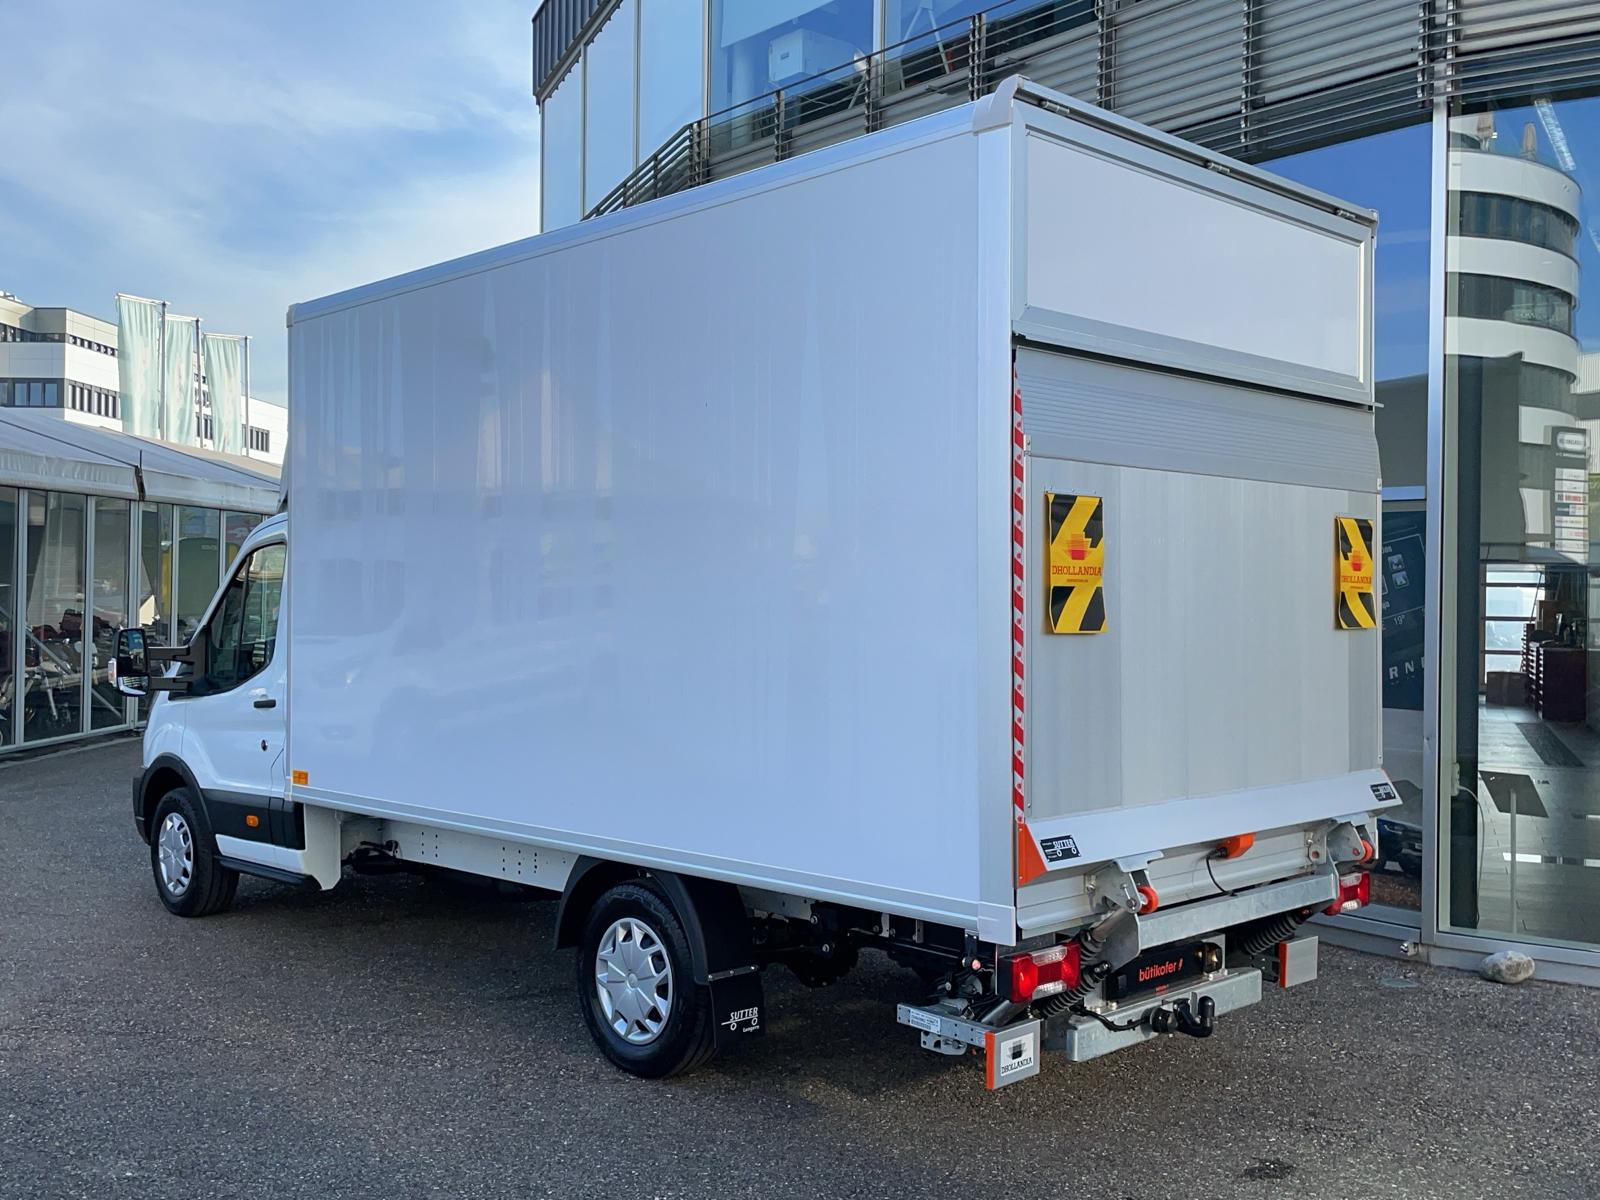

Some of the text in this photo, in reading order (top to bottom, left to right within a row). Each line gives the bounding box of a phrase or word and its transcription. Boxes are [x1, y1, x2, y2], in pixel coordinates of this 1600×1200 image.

[1051, 565, 1102, 576] DHOLLANDIA
[1053, 839, 1075, 849] SUTTER
[1139, 960, 1177, 982] bütikofer
[730, 1007, 759, 1021] SUTTER
[1001, 1057, 1033, 1074] DHOLLANDIA
